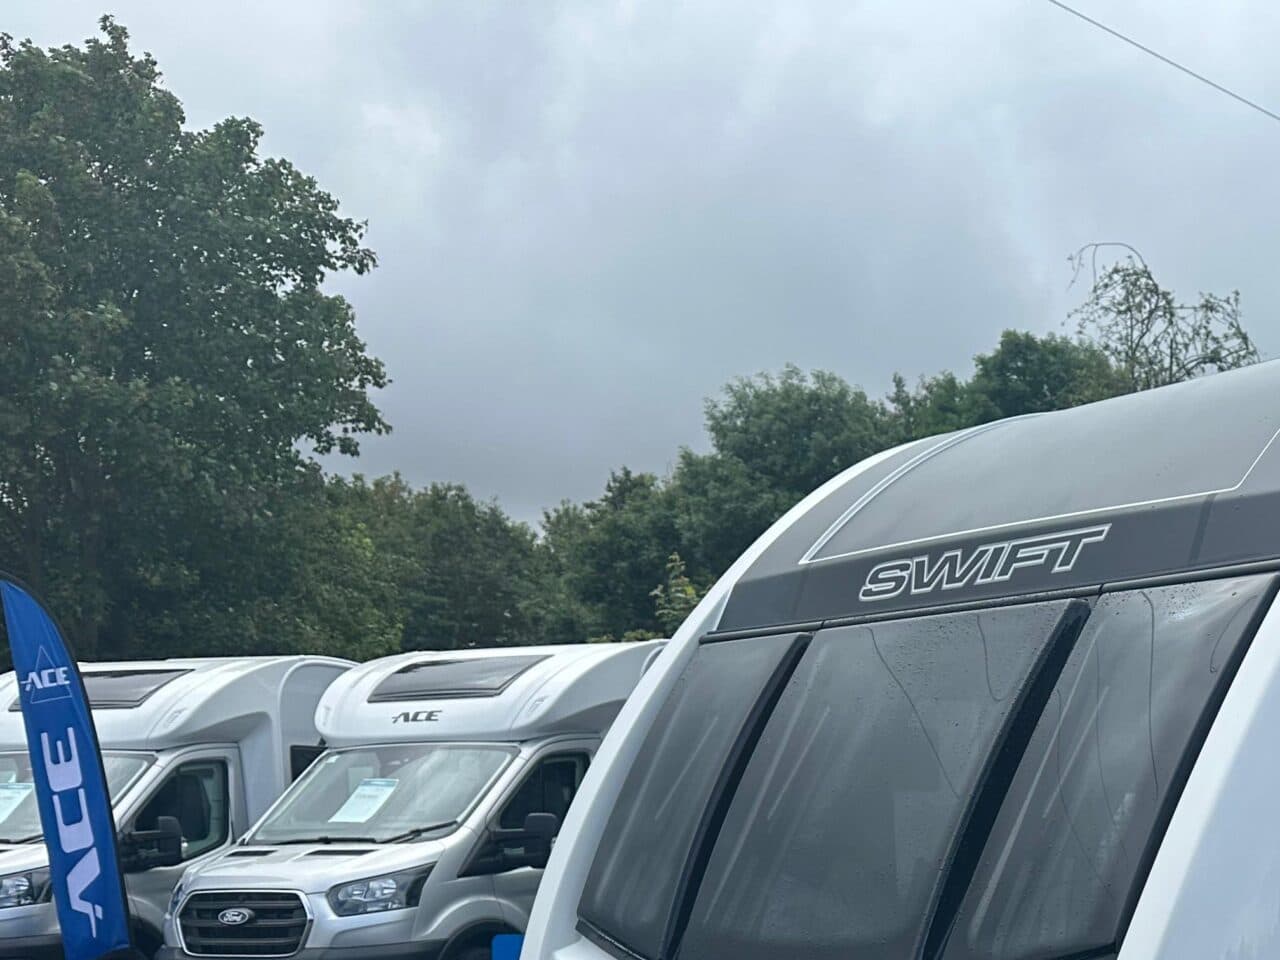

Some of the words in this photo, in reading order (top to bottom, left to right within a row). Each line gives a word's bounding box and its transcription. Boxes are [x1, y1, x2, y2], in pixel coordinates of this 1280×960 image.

[859, 523, 1112, 600] SWIFT
[20, 666, 70, 691] ACE
[392, 710, 442, 724] ACE
[40, 727, 102, 938] ACE
